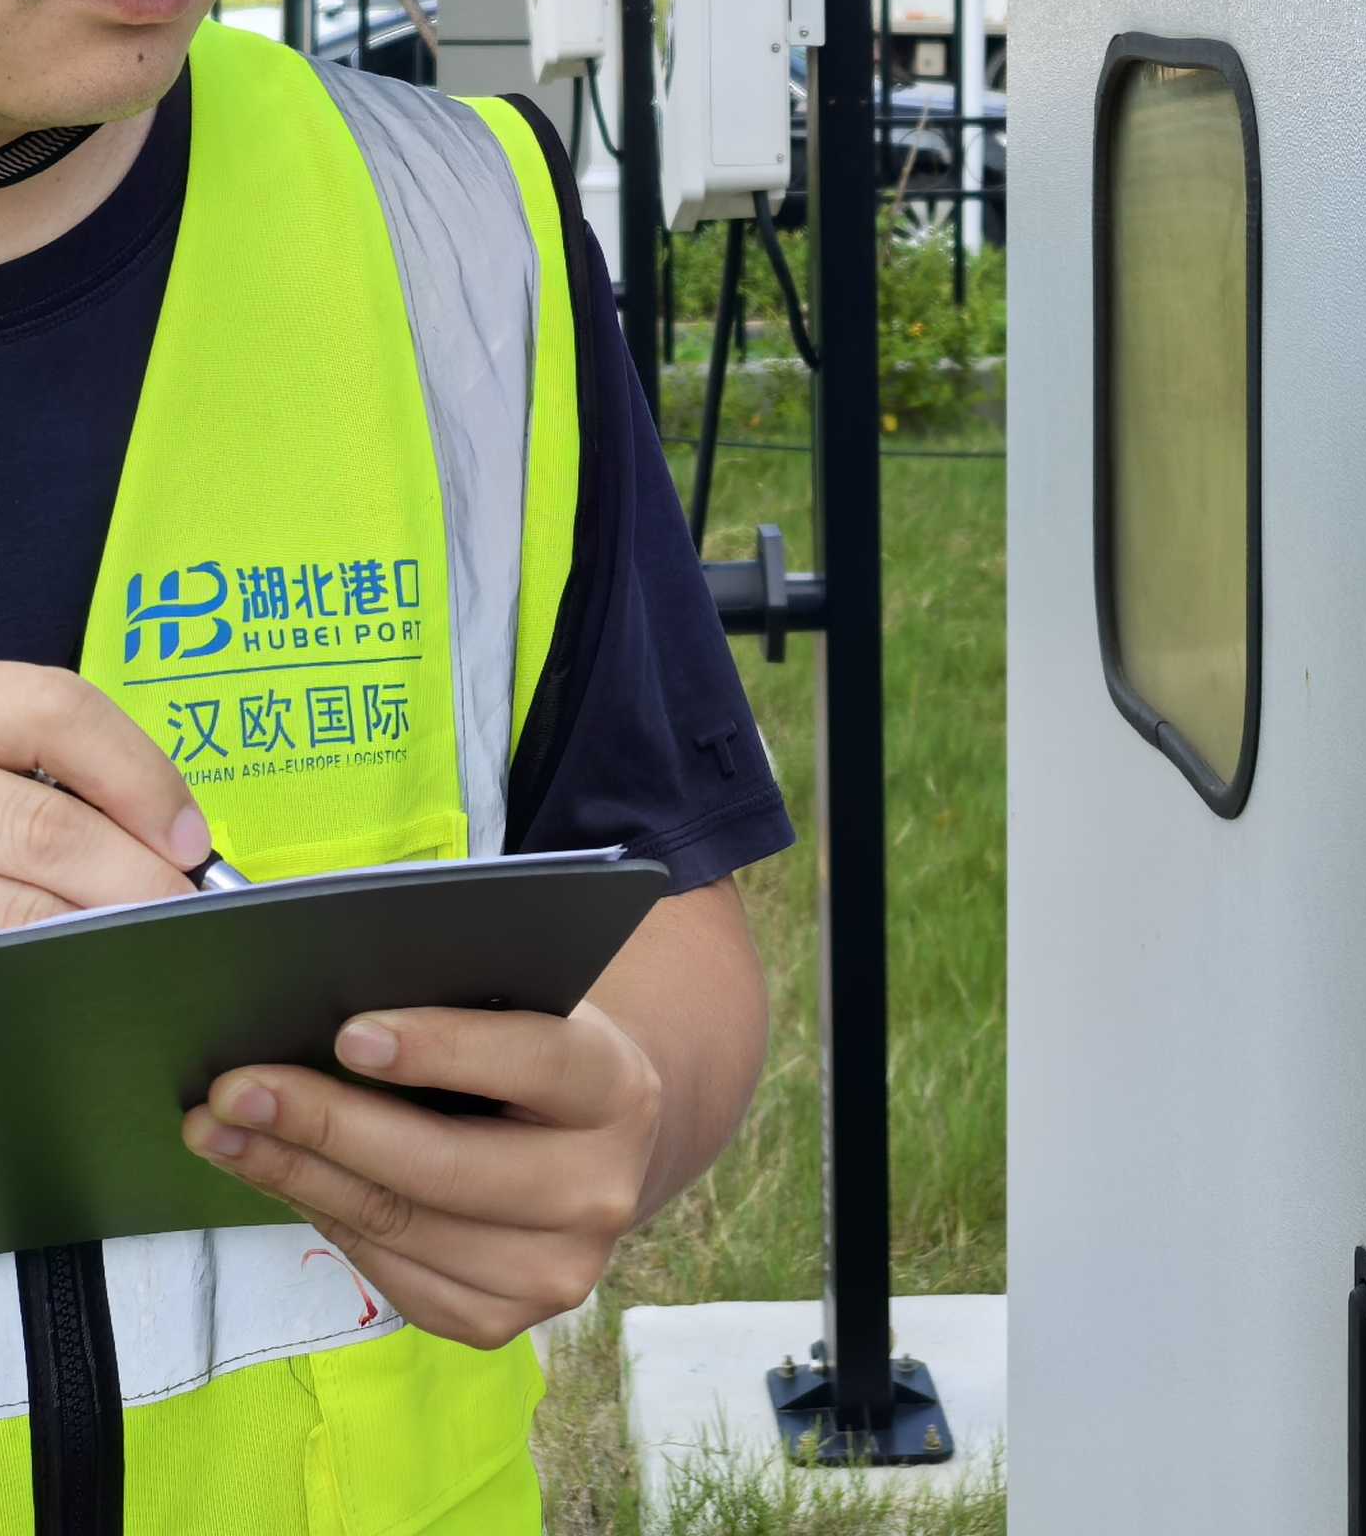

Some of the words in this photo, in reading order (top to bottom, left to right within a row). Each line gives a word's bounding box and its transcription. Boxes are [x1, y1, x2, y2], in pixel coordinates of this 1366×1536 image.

[235, 559, 420, 623] 湖北港口
[243, 625, 341, 653] HUBEI
[355, 620, 421, 645] PORT
[167, 683, 409, 763] 汉欧国际
[183, 766, 235, 786] UHAN
[242, 754, 341, 778] ASIA-EUROPE
